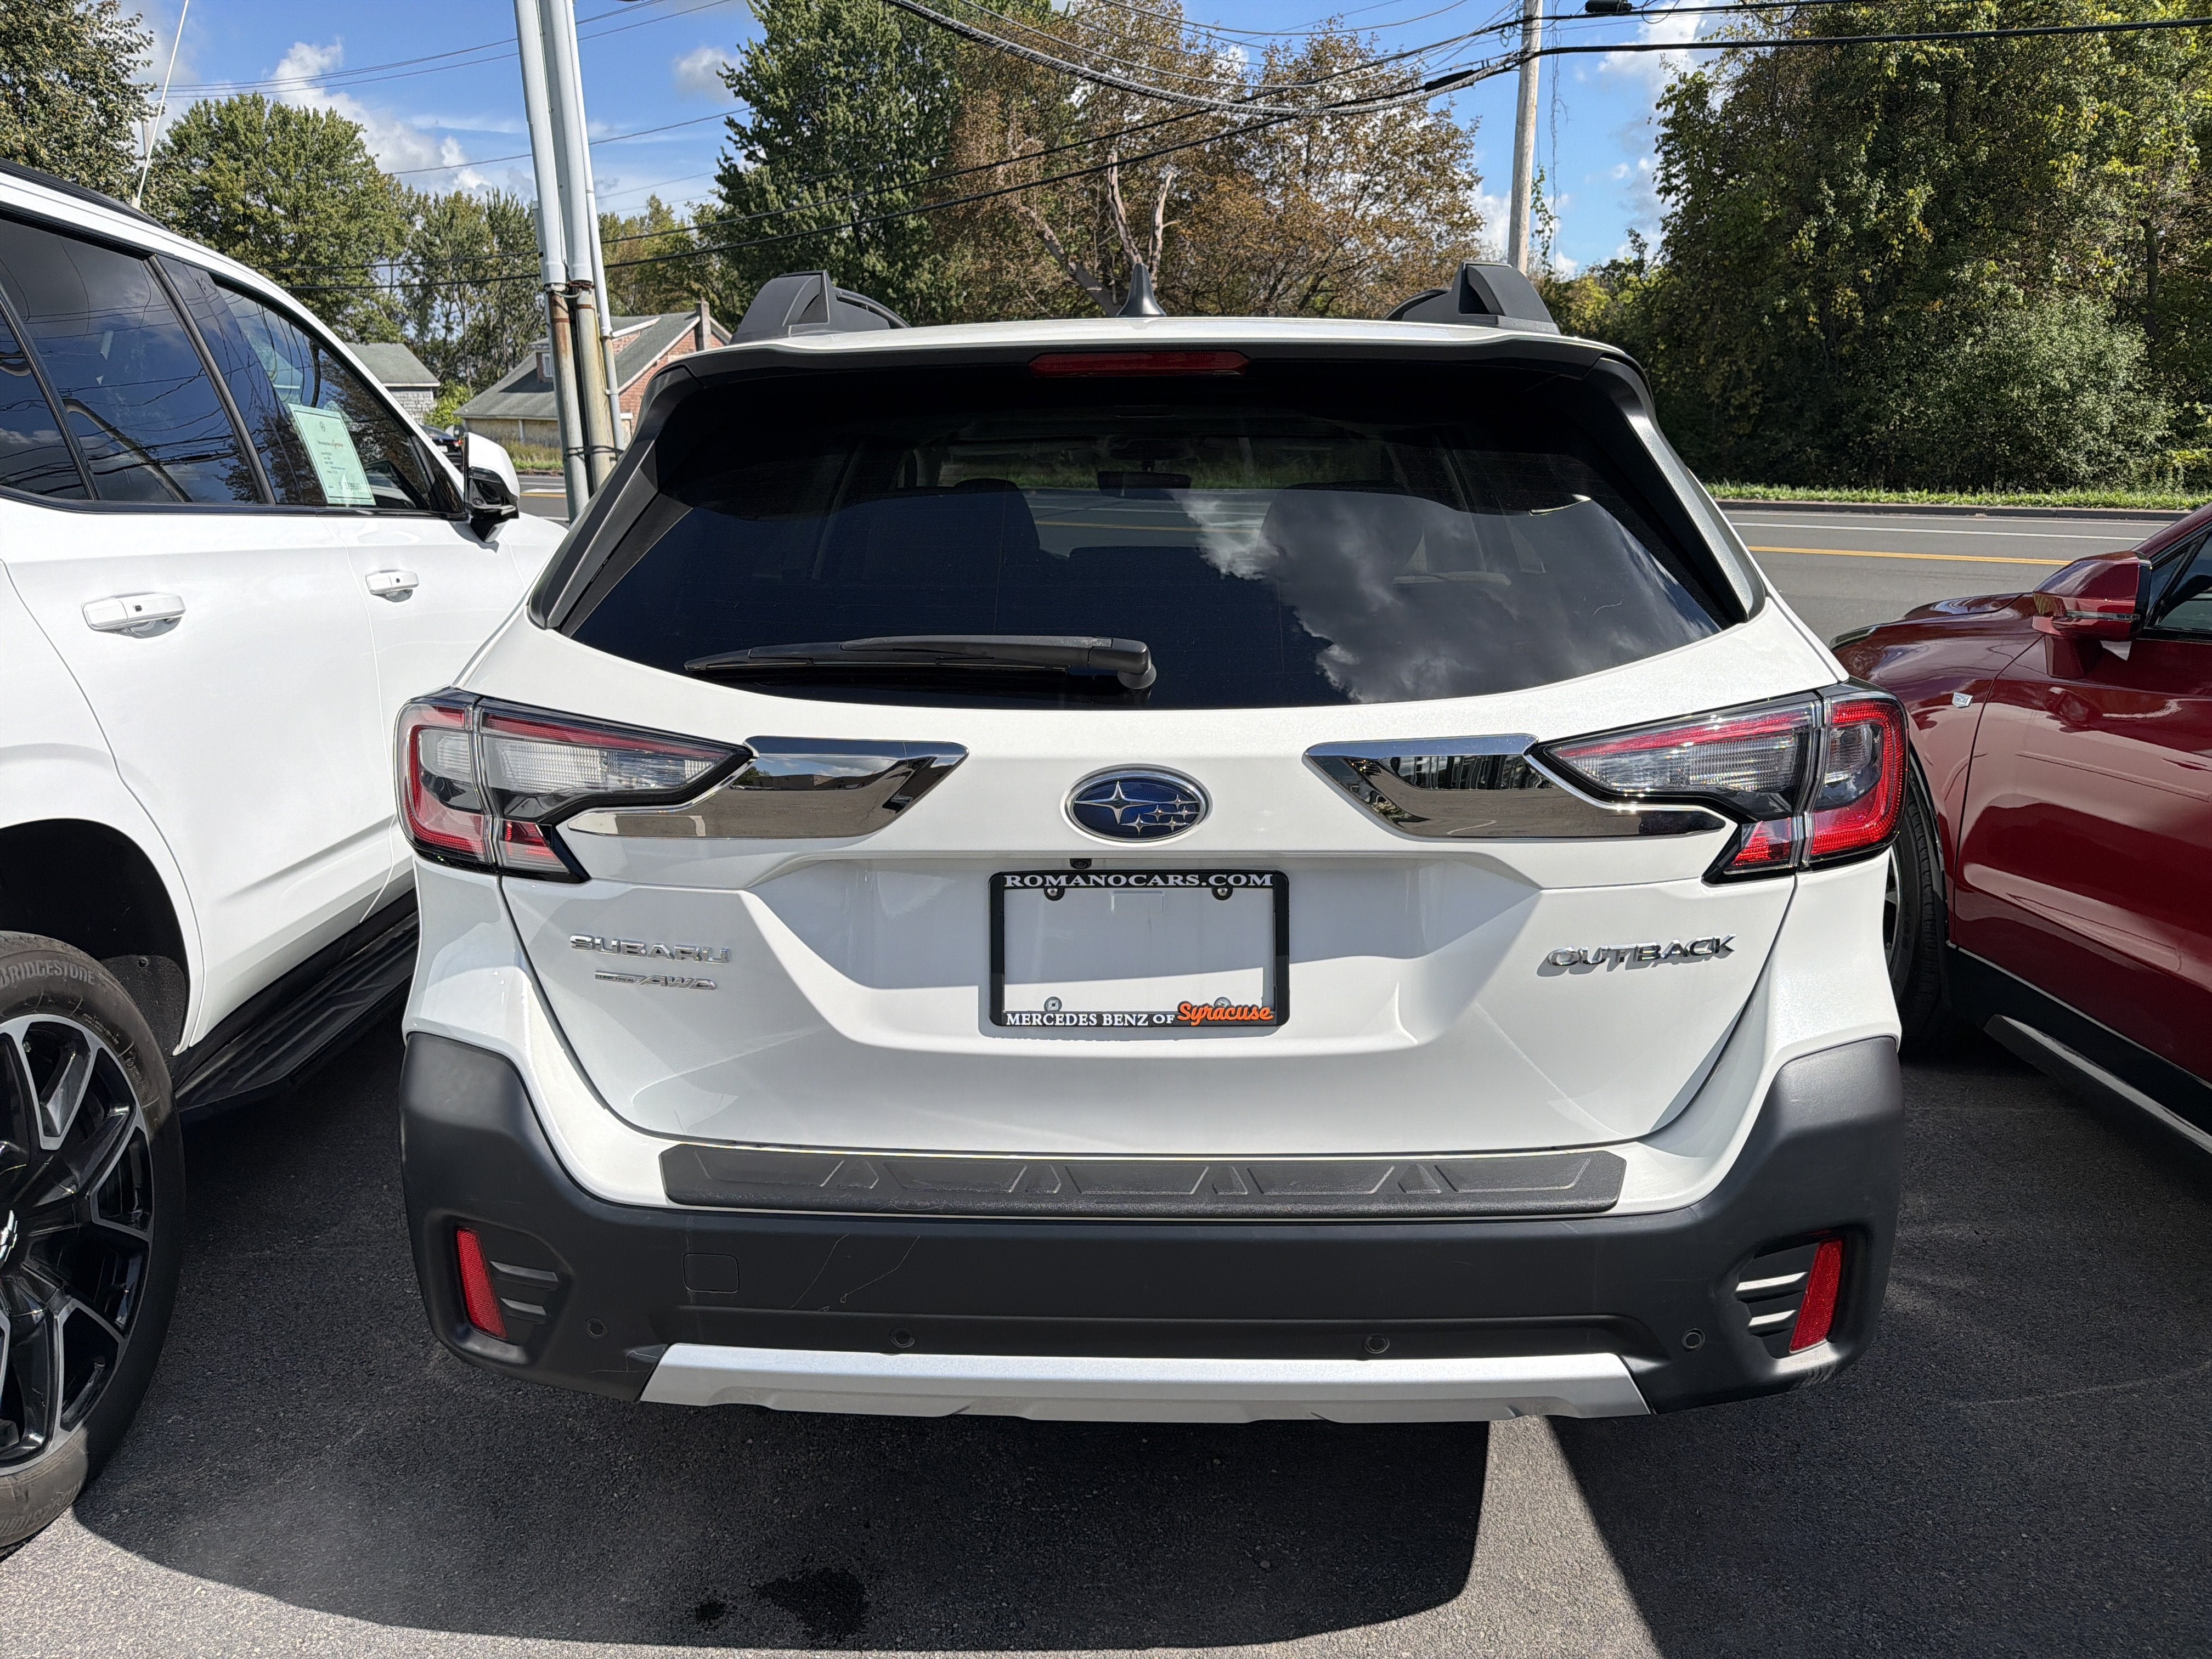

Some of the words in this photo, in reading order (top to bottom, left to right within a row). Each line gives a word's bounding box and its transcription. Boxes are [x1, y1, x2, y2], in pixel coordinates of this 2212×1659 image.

[1004, 874, 1273, 887] ROMANOCARS.COM
[569, 934, 730, 964] SUBARU
[1547, 933, 1737, 967] OUTBACK
[0, 960, 95, 989] BRIDGESTONE
[637, 975, 716, 990] AWD
[1006, 1013, 1097, 1026] MERCEDES
[1102, 1013, 1149, 1026] BENZ
[1153, 1013, 1175, 1025] OF
[1177, 1002, 1273, 1027] Syracuse
